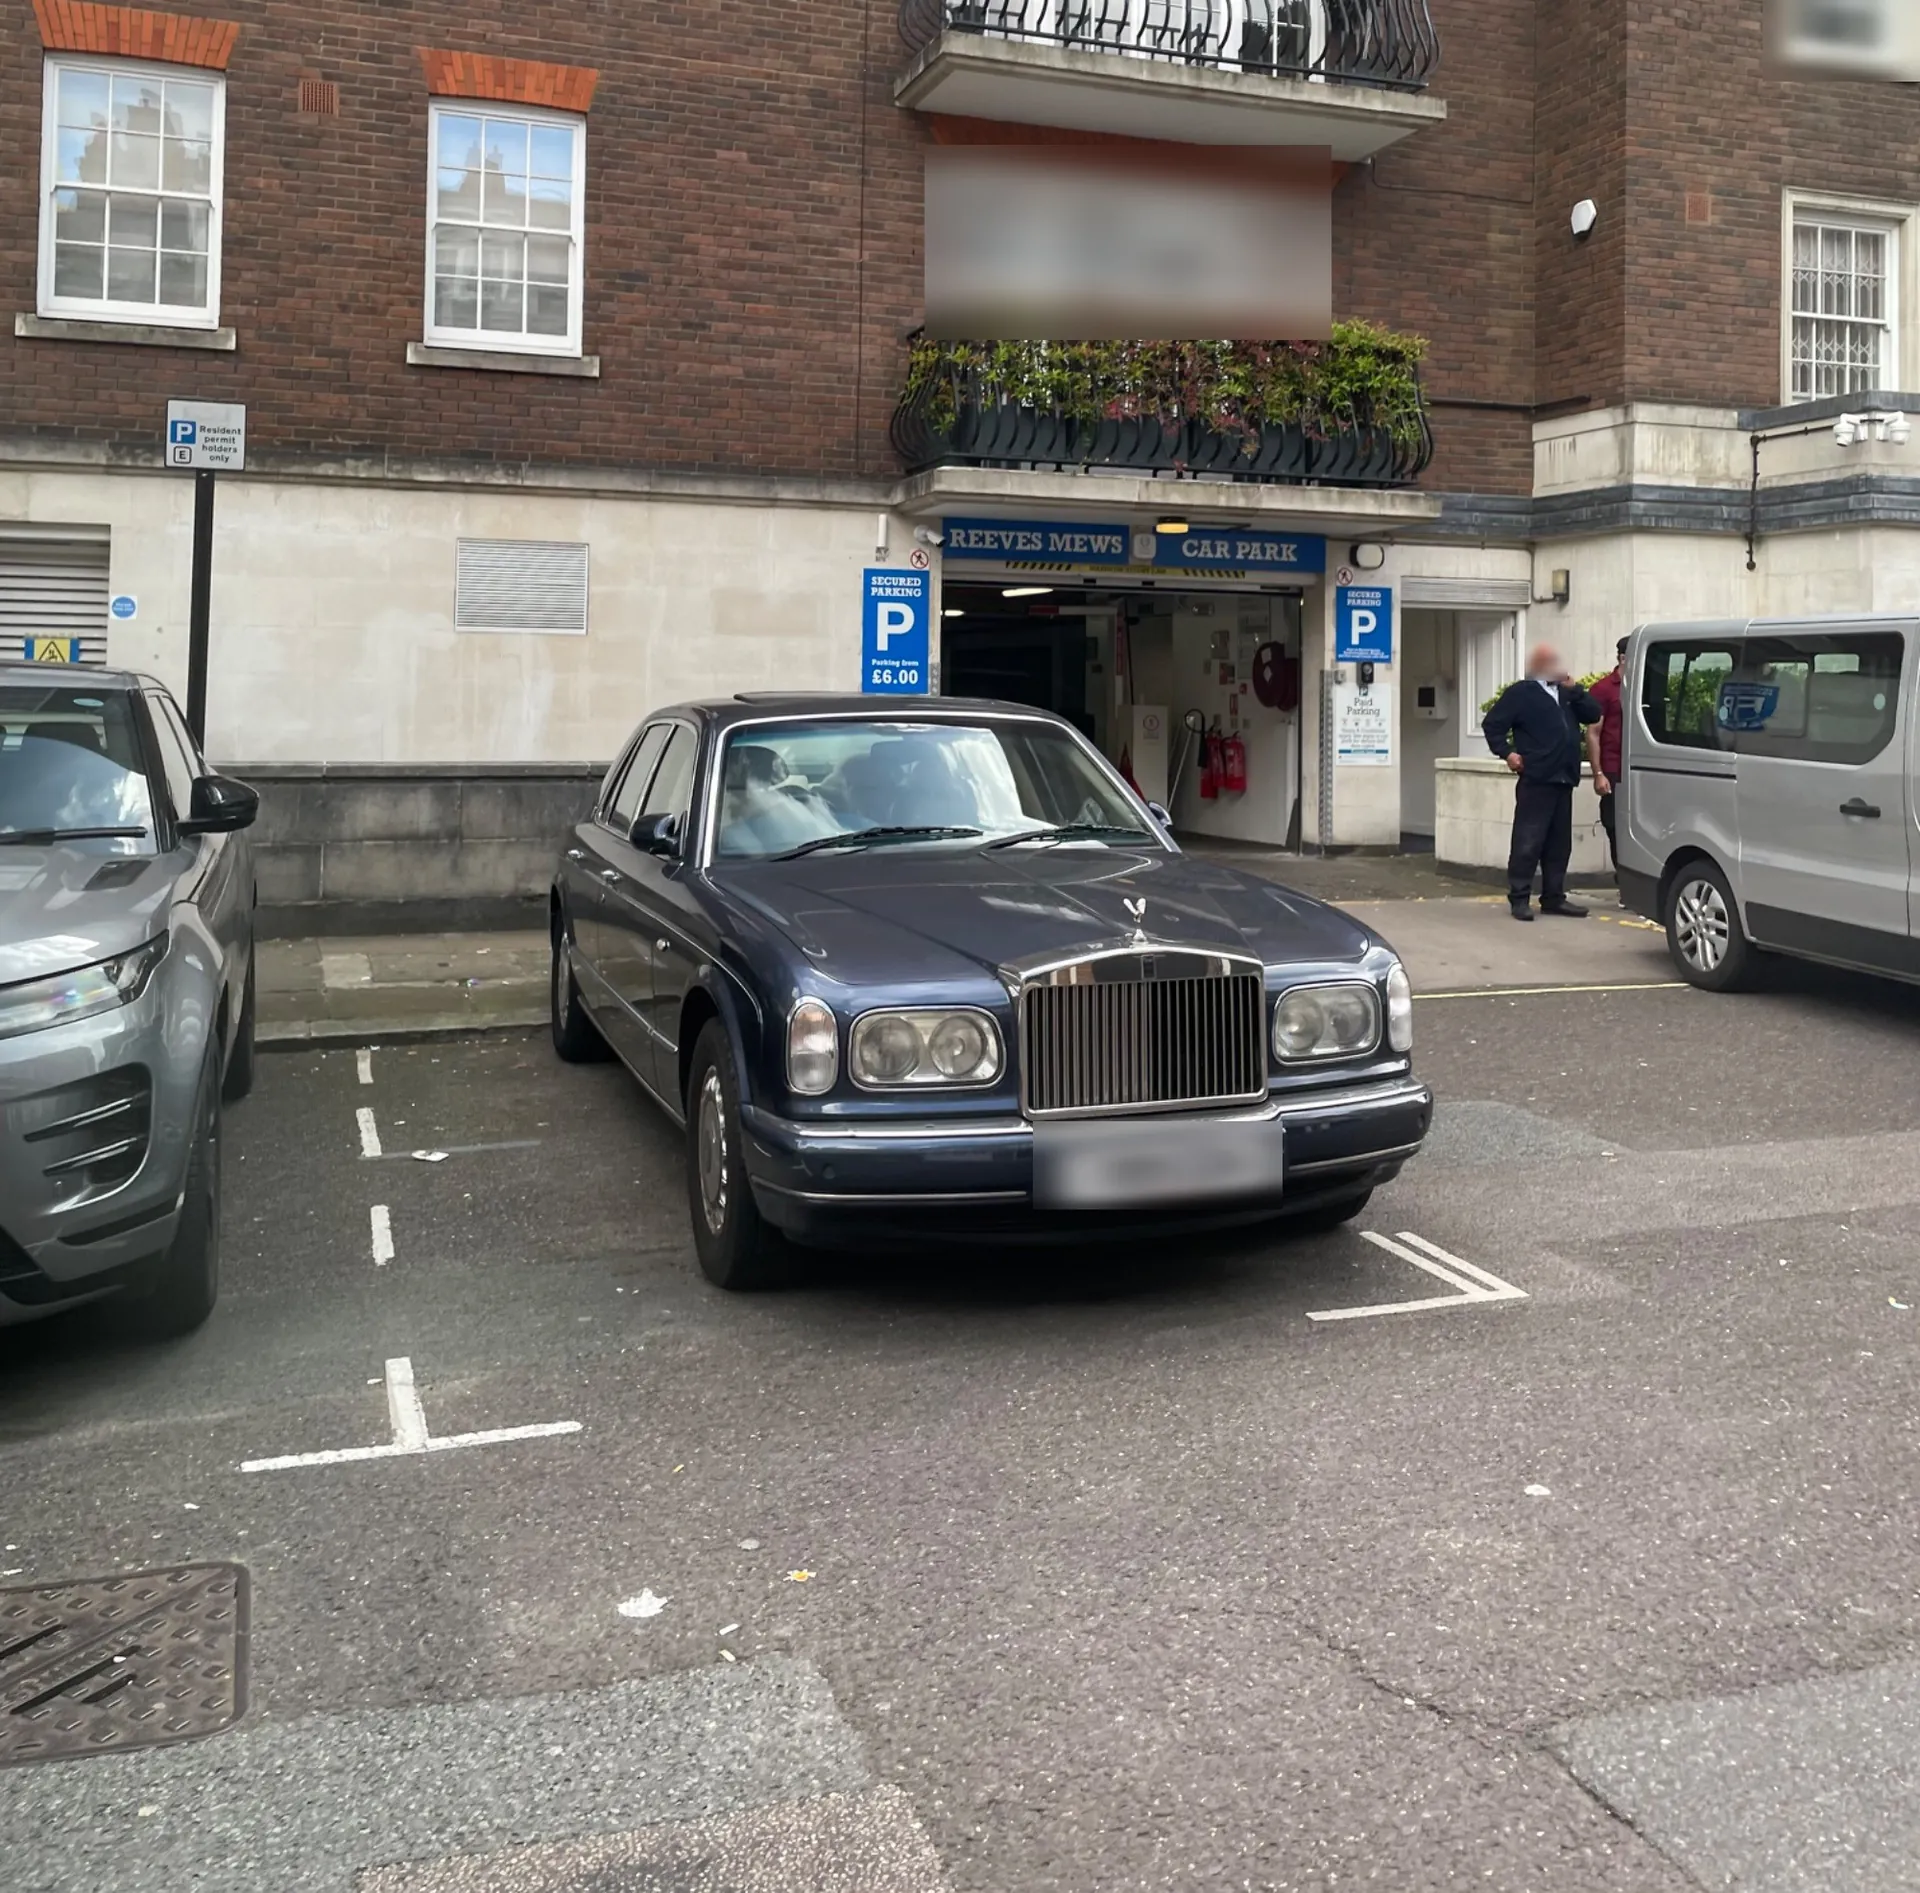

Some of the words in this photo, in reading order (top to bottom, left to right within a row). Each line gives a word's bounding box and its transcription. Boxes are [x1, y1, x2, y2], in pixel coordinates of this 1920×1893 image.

[177, 423, 193, 442] P
[200, 425, 242, 435] Resident
[204, 436, 236, 445] permit
[202, 444, 238, 454] holders
[179, 450, 187, 460] E
[209, 454, 230, 464] only
[949, 528, 1043, 551] REEVES
[1048, 533, 1123, 555] MEWS
[1182, 539, 1231, 559] CAR
[1235, 541, 1298, 562] PARK
[871, 576, 922, 587] SECURED
[870, 587, 922, 598] PARKING
[1346, 598, 1382, 607] PARKING
[877, 602, 915, 651] P
[1351, 609, 1377, 645] P
[871, 658, 900, 668] Parking
[872, 669, 919, 685] £6.00
[1354, 697, 1373, 706] Paid
[1346, 706, 1381, 717] Parking
